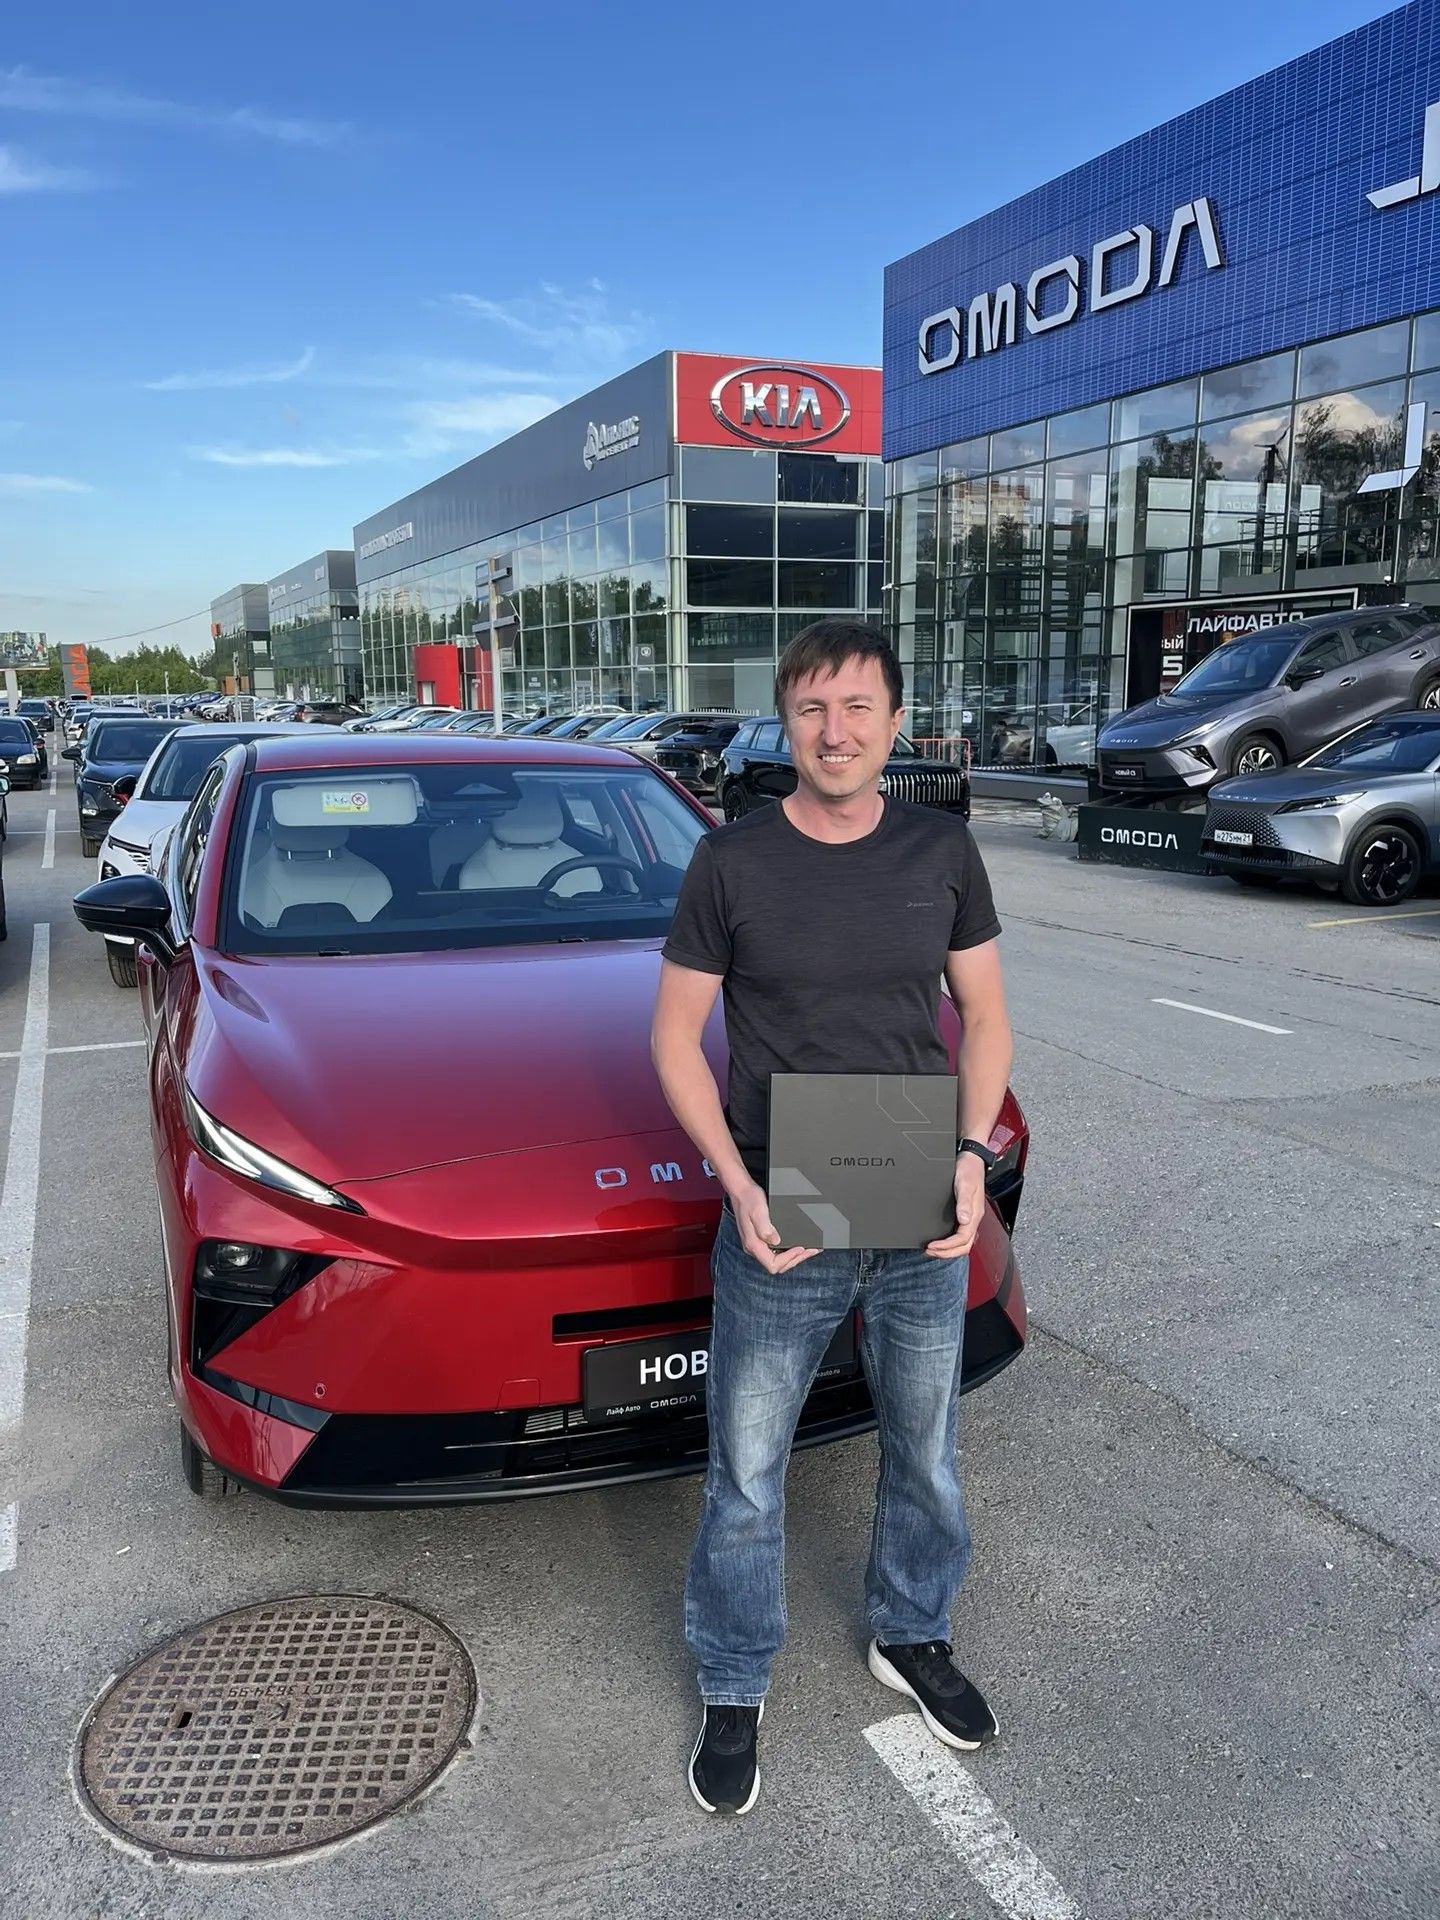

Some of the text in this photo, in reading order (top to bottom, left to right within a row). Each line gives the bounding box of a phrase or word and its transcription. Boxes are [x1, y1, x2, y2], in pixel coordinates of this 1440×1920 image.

[918, 196, 1222, 375] OMODA
[740, 381, 823, 430] KIA
[1161, 635, 1184, 649] ЫЙ
[1162, 655, 1184, 676] 5
[1101, 827, 1178, 850] OMODA
[830, 1156, 895, 1167] OMODA
[606, 1405, 641, 1416] Лайф Авто
[650, 1394, 697, 1409] OMODA
